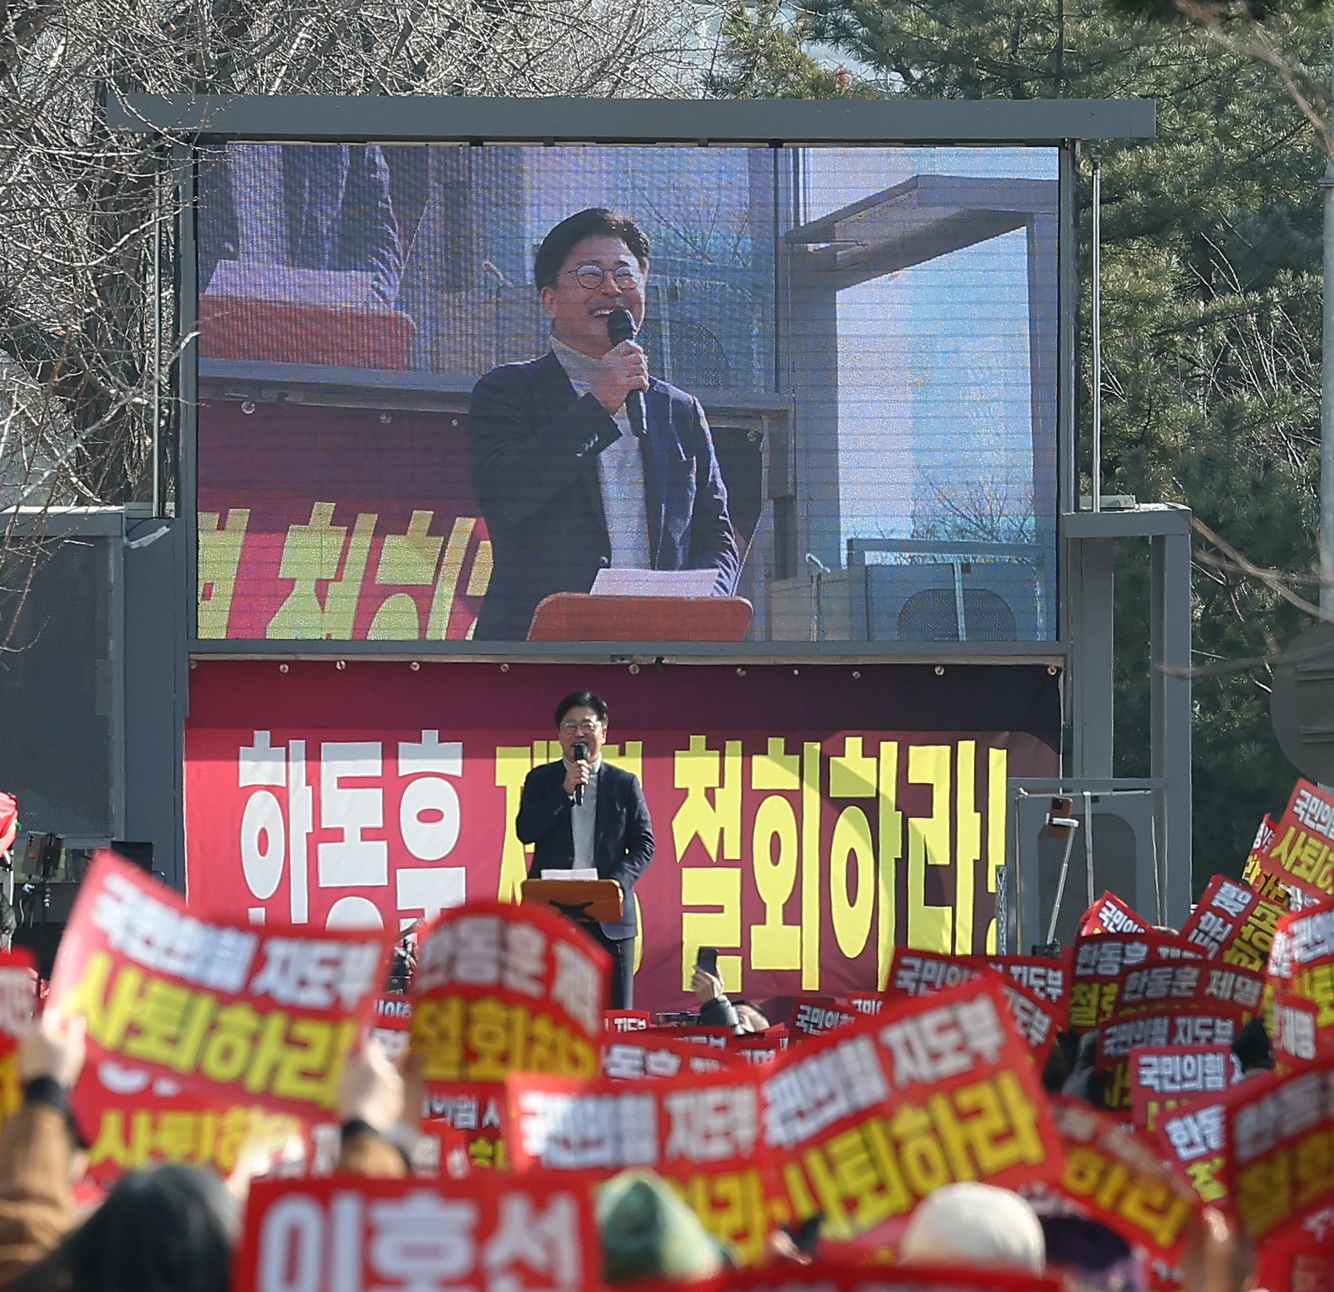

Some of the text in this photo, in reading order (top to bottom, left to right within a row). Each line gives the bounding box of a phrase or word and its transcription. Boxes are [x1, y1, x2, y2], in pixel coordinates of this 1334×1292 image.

[266, 502, 493, 640] 철회
[670, 735, 1008, 992] 철회하라!
[70, 950, 357, 1110] 사퇴하라
[881, 991, 1009, 1090] 지도부
[1138, 1052, 1227, 1093] 국민의힘
